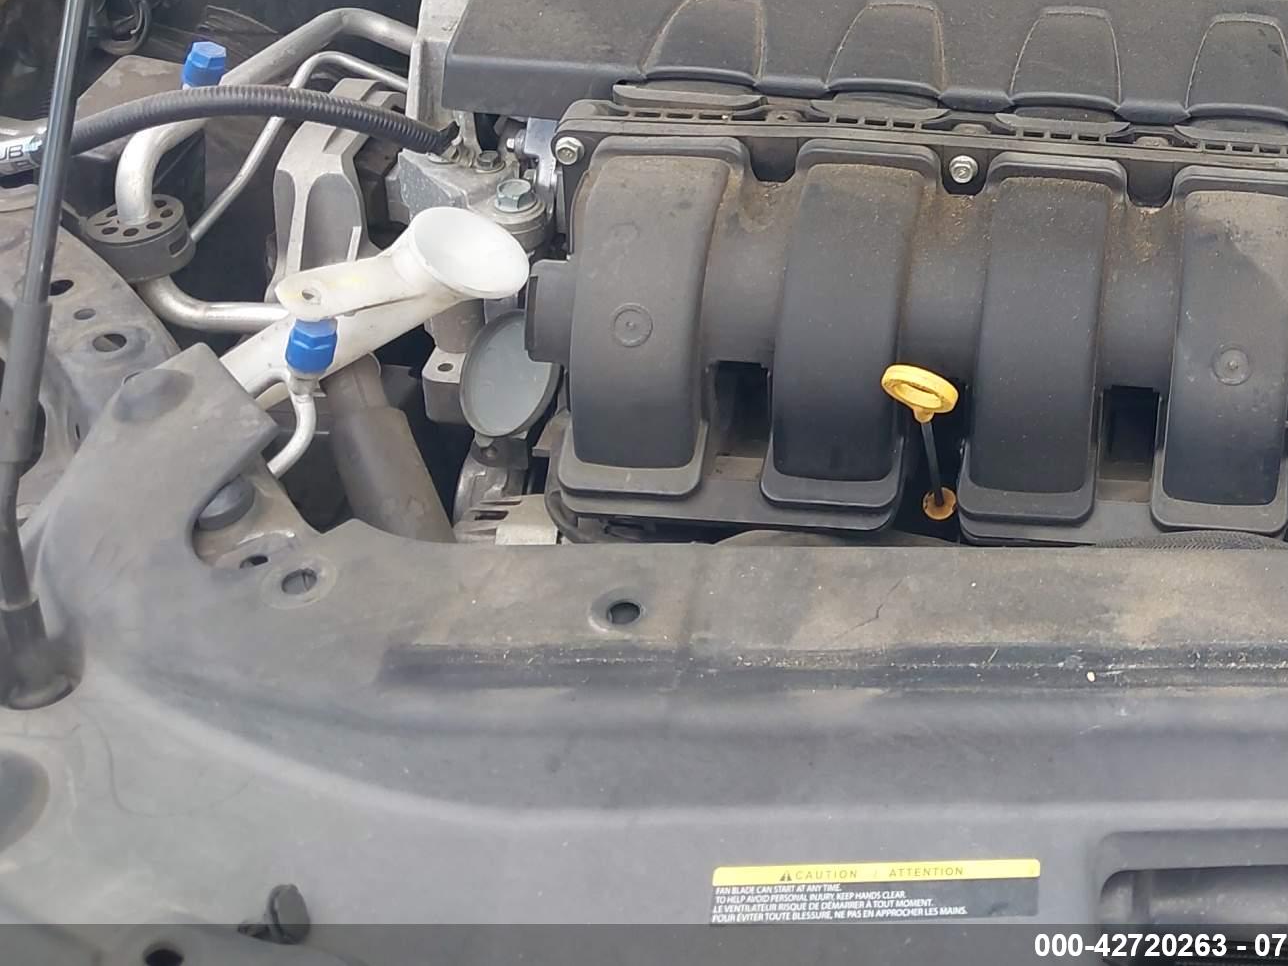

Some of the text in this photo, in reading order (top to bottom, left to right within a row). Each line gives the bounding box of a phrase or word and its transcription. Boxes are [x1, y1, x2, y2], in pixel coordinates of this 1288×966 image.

[795, 869, 858, 881] CAUTION
[888, 866, 964, 878] ATTENTION
[715, 886, 730, 894] FAN
[731, 886, 754, 894] BLADE
[756, 886, 772, 894] CAN
[774, 884, 796, 893] START
[806, 884, 822, 892] ANY
[716, 896, 726, 904] TO
[726, 895, 746, 904] HELP
[746, 894, 770, 903] AVOID
[770, 894, 808, 902] PERSONAL
[836, 892, 854, 901] KEEP
[855, 891, 881, 900] HANDS
[713, 905, 724, 914] LE
[724, 903, 776, 913] VENTILATEUR
[808, 902, 820, 910] DE
[873, 900, 894, 908] TOUT
[712, 914, 736, 923] POUR
[764, 912, 791, 921] TOUTE
[834, 910, 846, 919] NE
[847, 910, 862, 918] PAS
[862, 909, 874, 918] EN
[875, 908, 924, 918] APPROCHER
[924, 907, 938, 916] LES
